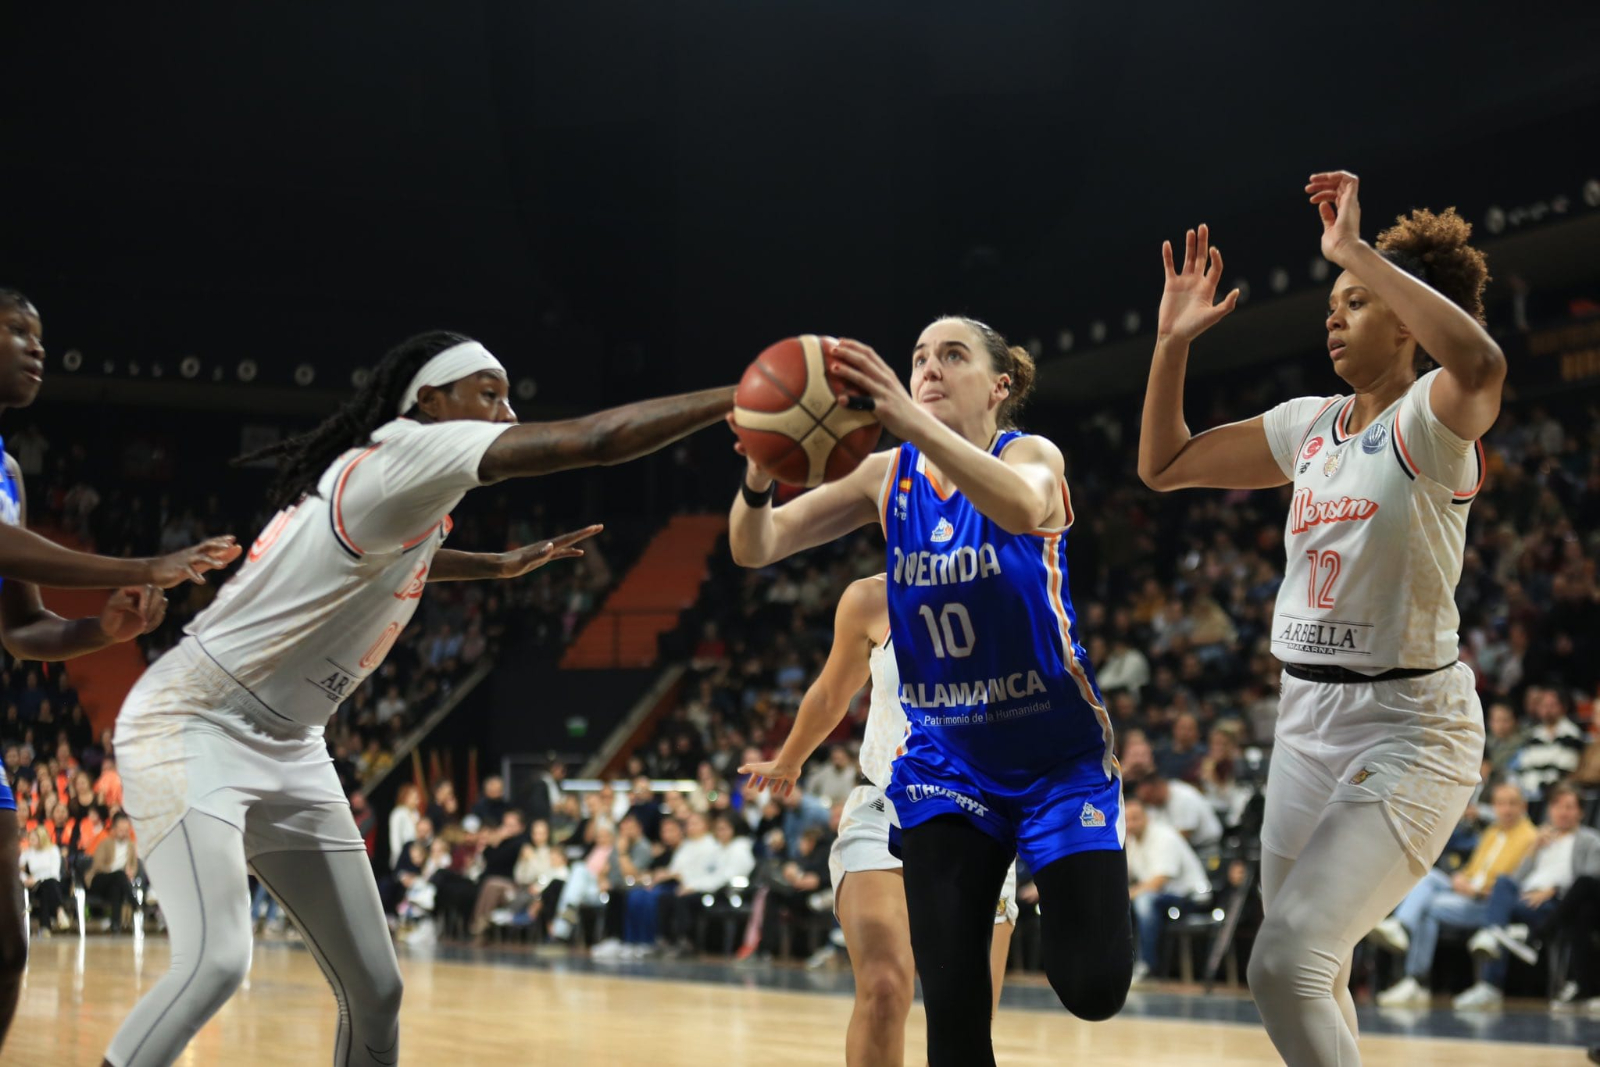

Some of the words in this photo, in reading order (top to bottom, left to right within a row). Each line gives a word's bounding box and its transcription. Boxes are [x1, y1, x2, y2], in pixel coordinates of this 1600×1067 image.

[1291, 487, 1379, 535] Mersin
[1306, 550, 1341, 609] 12
[918, 602, 976, 658] 10
[1279, 622, 1356, 649] ARBELLA
[1287, 642, 1336, 656] MAKARNA
[900, 670, 1048, 708] ALAMANCA
[924, 714, 970, 726] Patrimonio
[972, 713, 984, 723] de
[986, 712, 995, 723] la
[996, 700, 1051, 719] Humanidad
